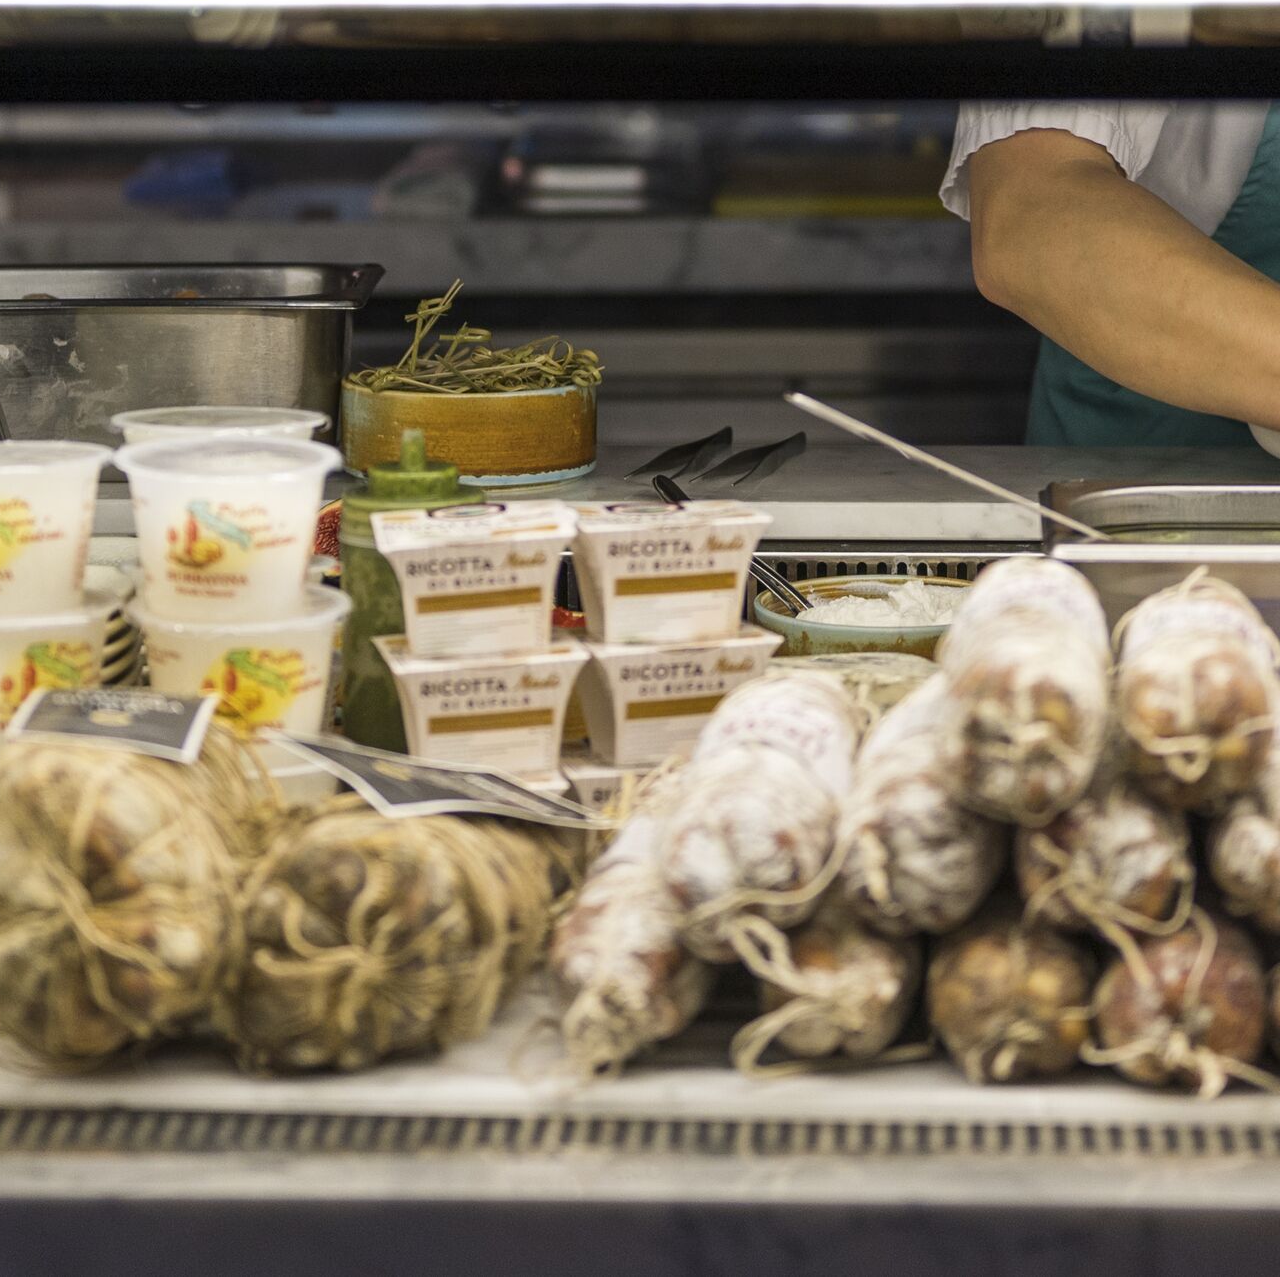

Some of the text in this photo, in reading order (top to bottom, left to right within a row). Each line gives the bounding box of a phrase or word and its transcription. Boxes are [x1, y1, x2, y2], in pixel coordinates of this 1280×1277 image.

[606, 539, 694, 559] RICOTTA
[406, 556, 494, 577] RICOTTA
[620, 660, 704, 683] RICOTTA
[420, 676, 508, 698] RICOTTA
